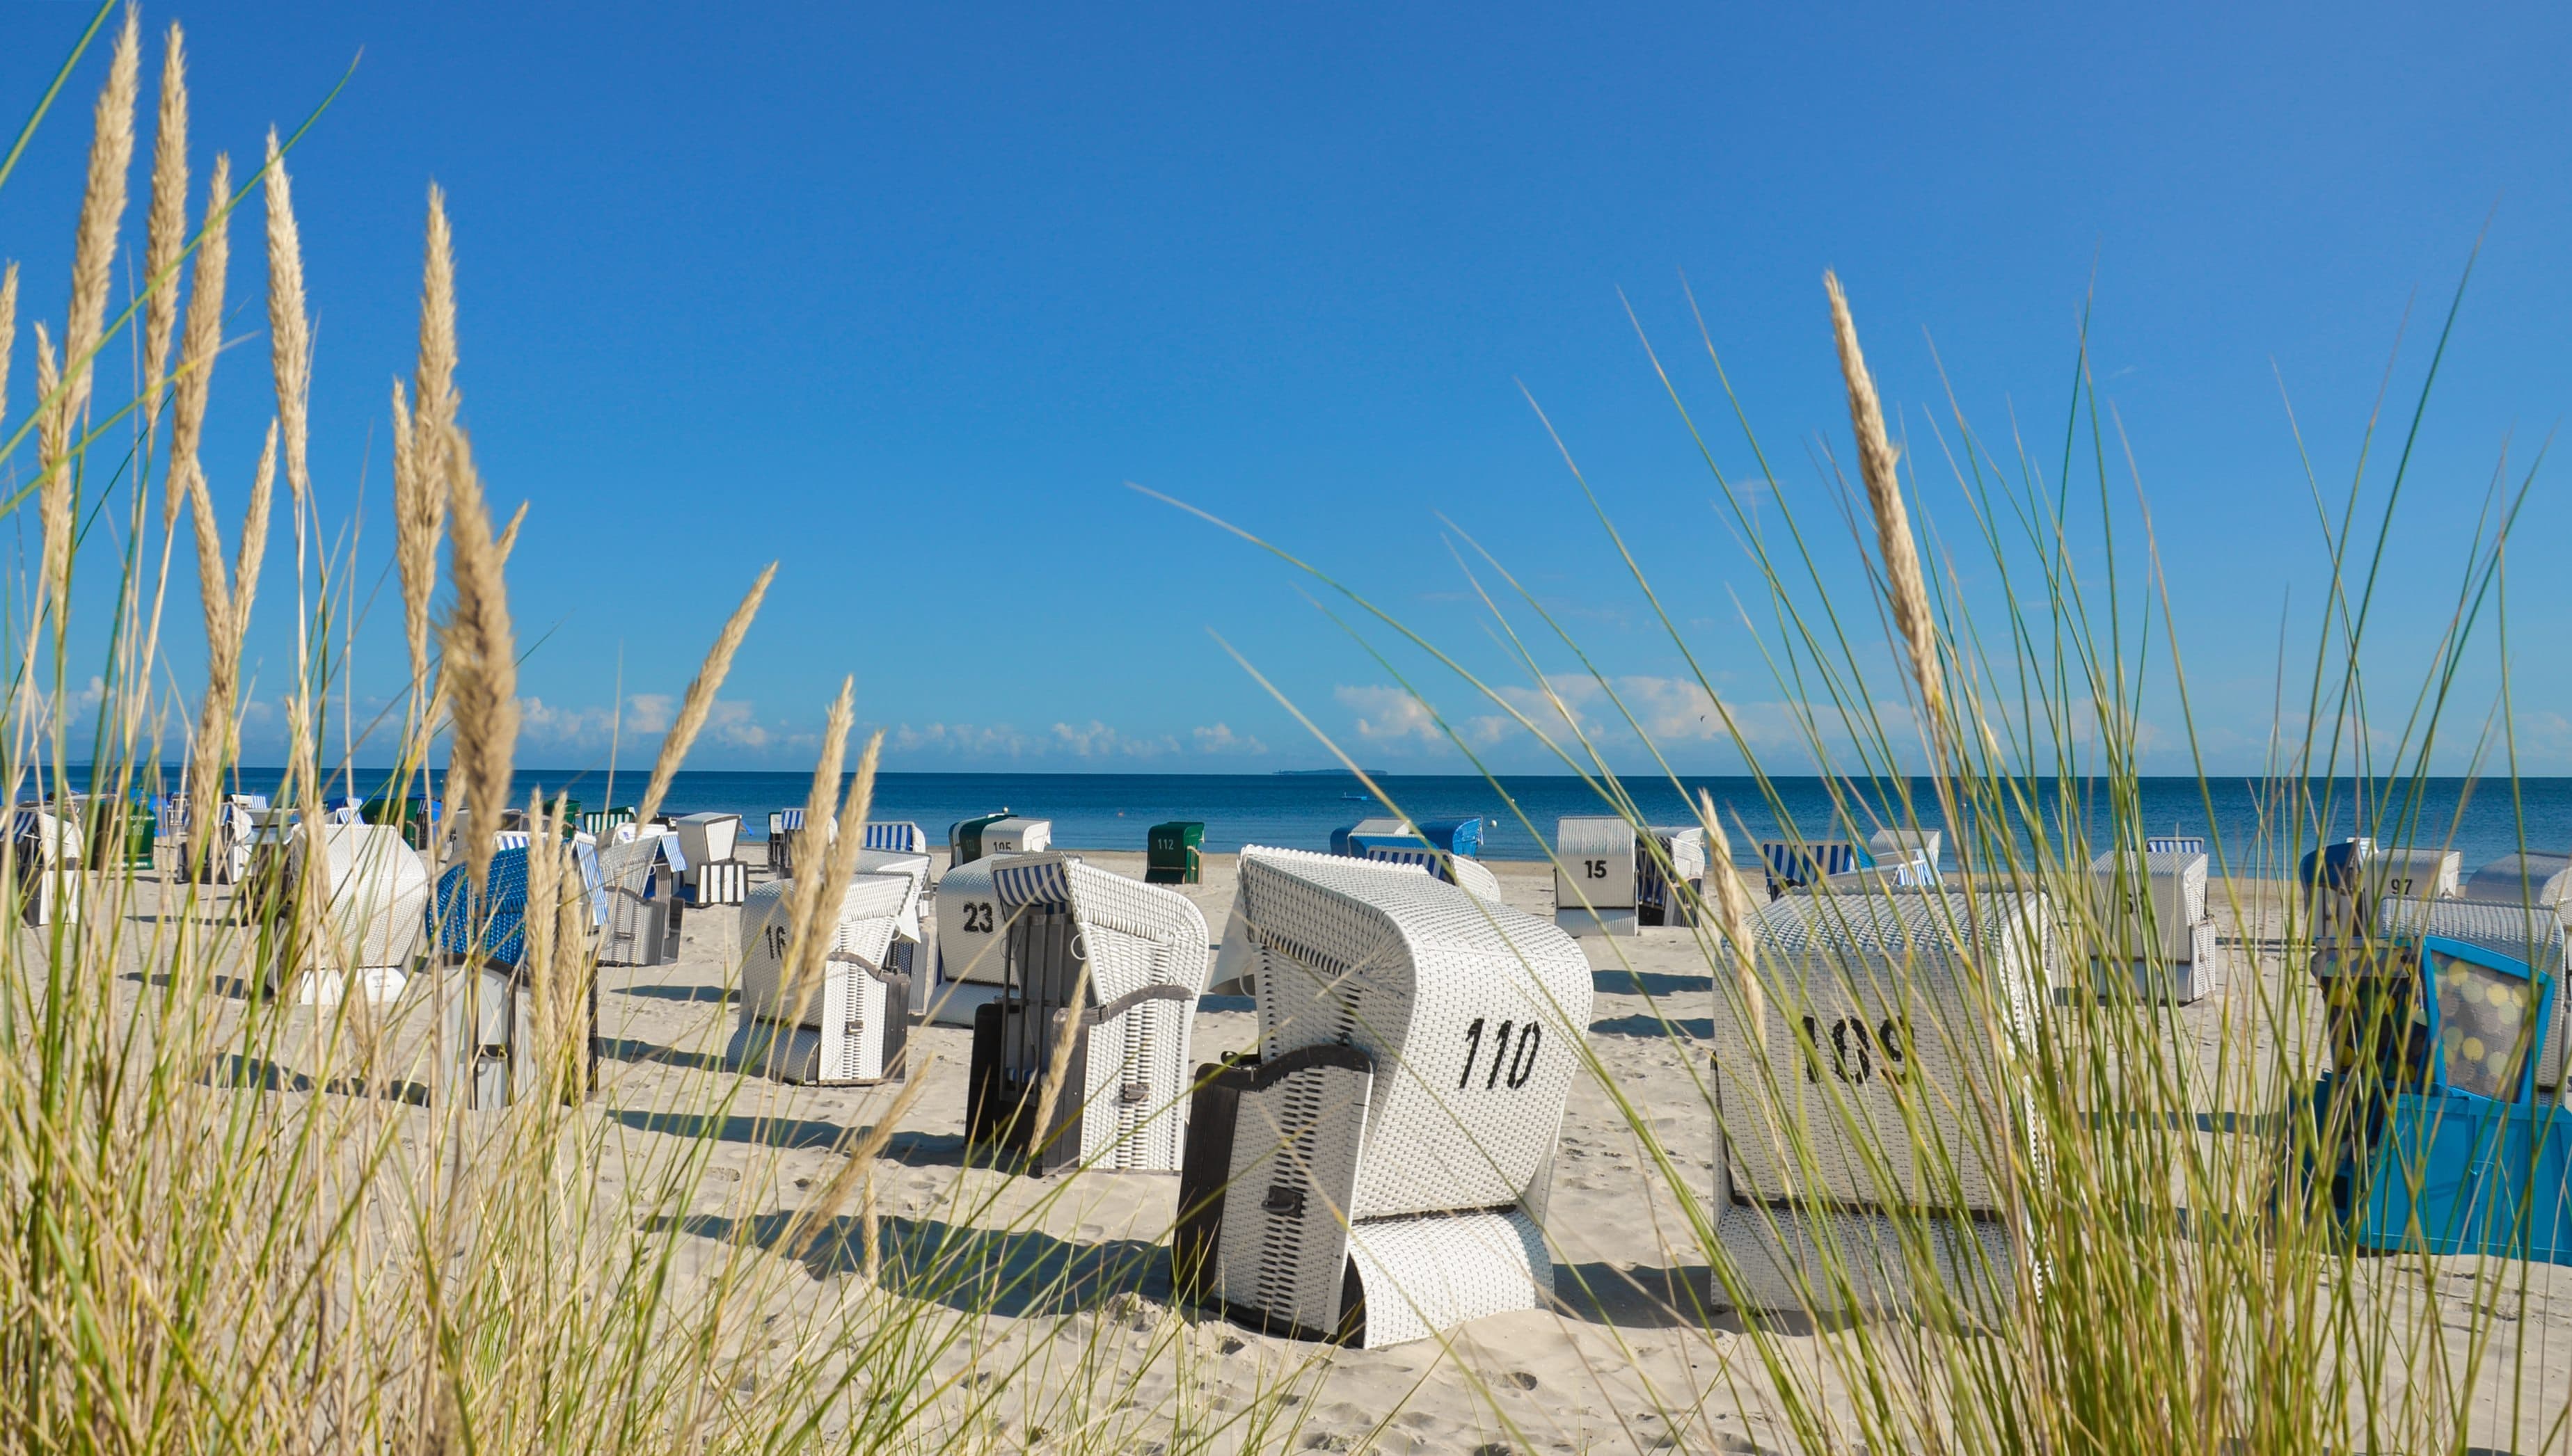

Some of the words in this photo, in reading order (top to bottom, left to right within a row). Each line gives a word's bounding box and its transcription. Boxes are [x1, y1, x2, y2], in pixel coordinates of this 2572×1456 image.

[994, 841, 1012, 852] 105
[1158, 838, 1174, 850] 112
[1585, 860, 1607, 879] 15
[2391, 879, 2413, 895] 97
[963, 902, 994, 933] 23
[1459, 1018, 1542, 1090] 110
[1801, 1016, 1916, 1085] 109
